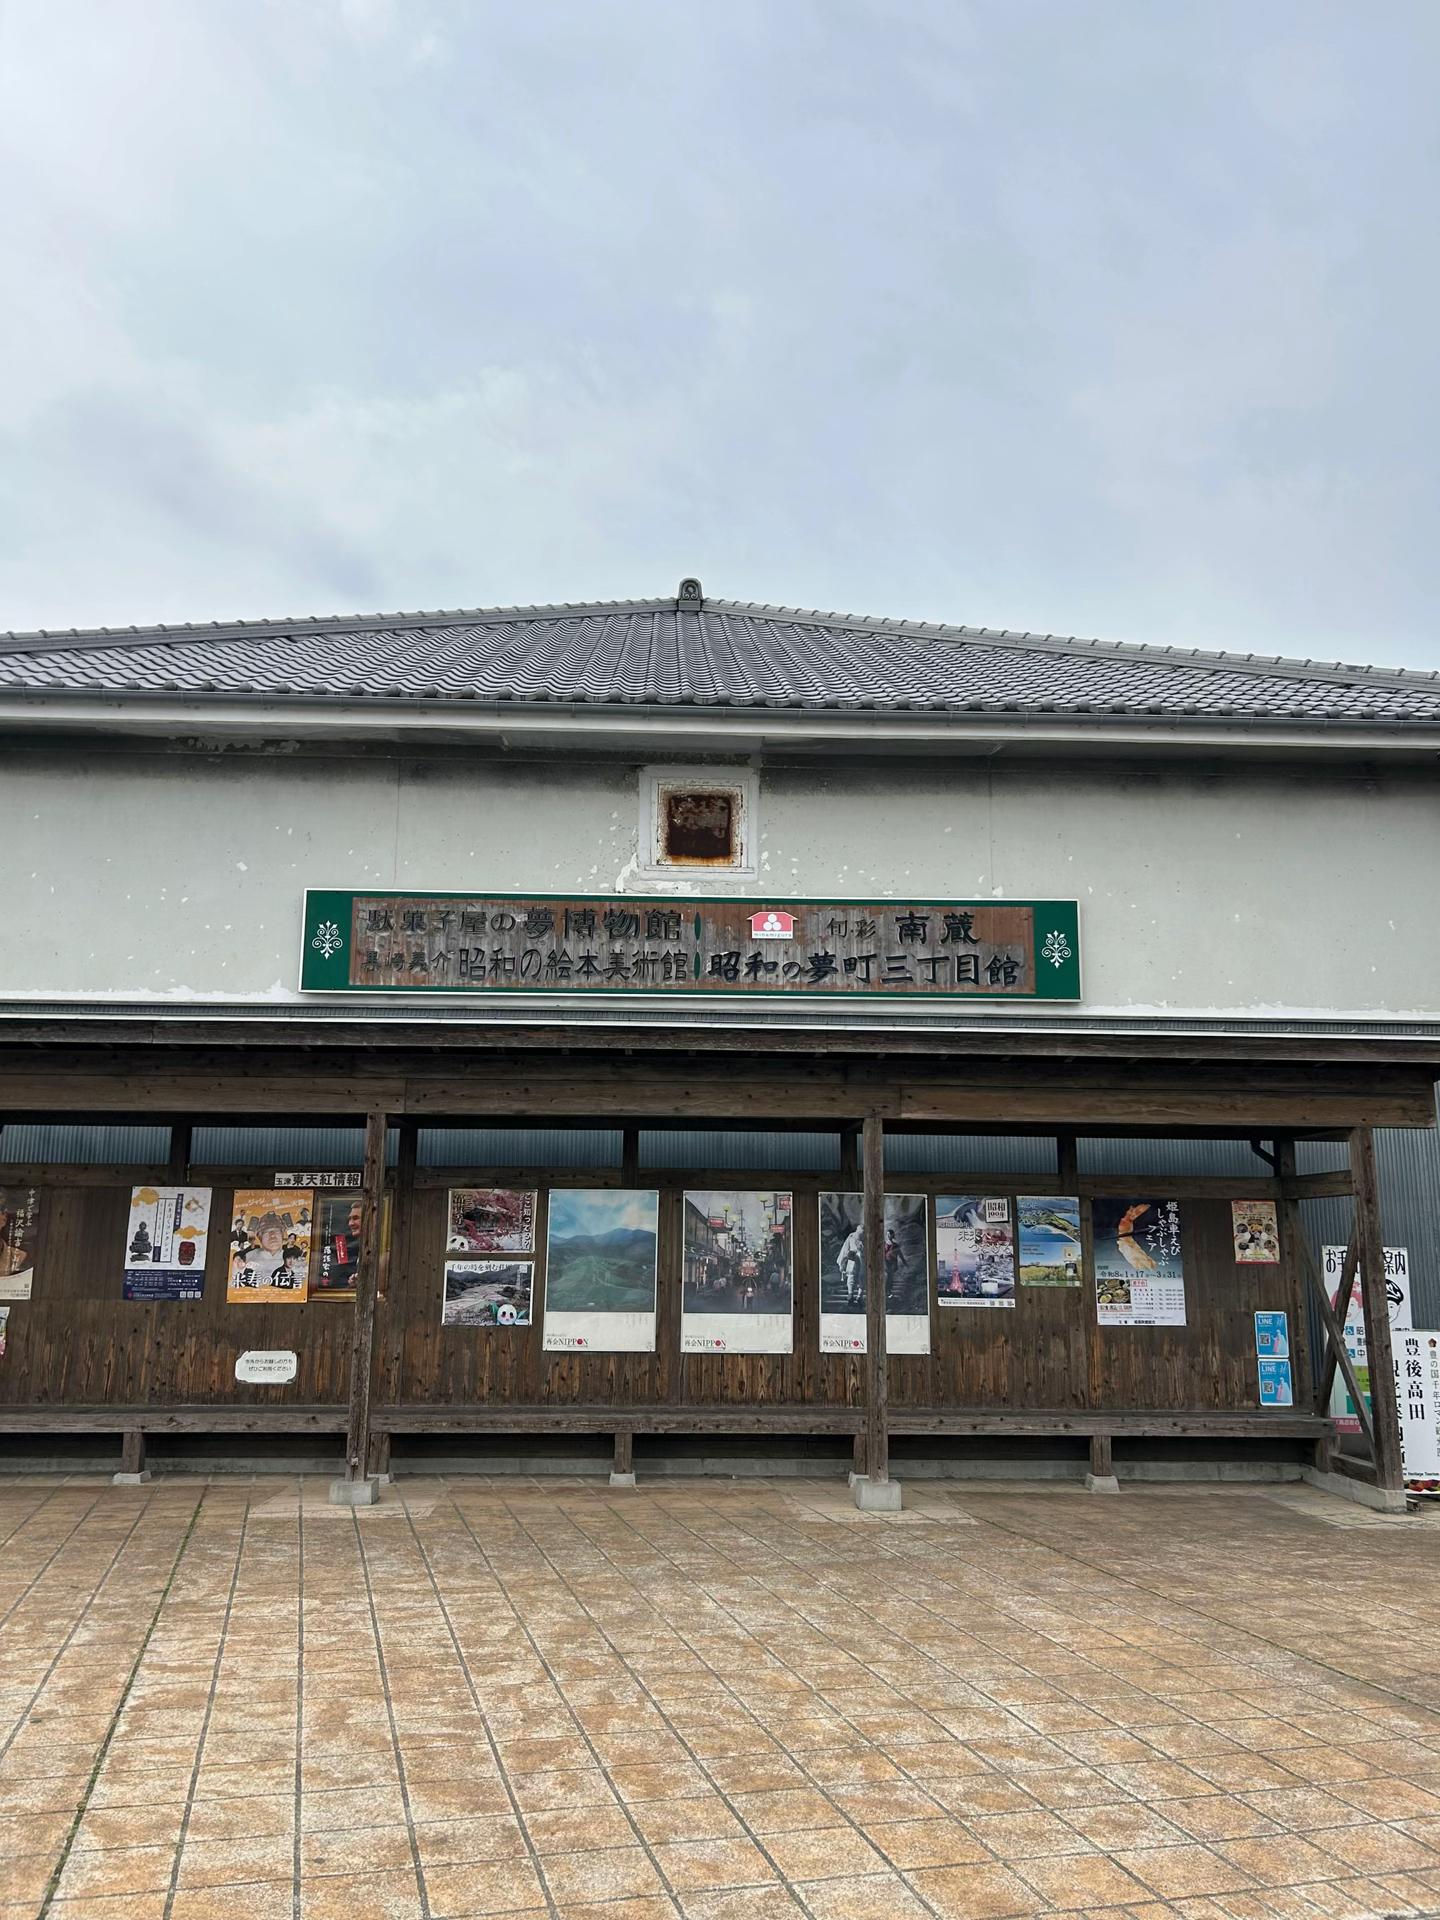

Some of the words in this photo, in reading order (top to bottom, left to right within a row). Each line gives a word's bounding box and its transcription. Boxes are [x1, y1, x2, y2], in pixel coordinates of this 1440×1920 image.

[367, 907, 683, 941] 駄菓子屋の夢博物館
[895, 911, 981, 944] 南蔵
[459, 948, 688, 981] 昭和の絵本美術館
[707, 951, 1020, 986] 昭和の夢町三丁目館
[1145, 1224, 1158, 1252] フェア
[1156, 1208, 1170, 1266] しゃぶしゃぶ
[1166, 1201, 1181, 1256] 姫島車えび
[231, 1270, 305, 1289] 米寿の伝言
[1261, 1365, 1277, 1373] LINE
[1405, 1338, 1425, 1420] 豊後高田
